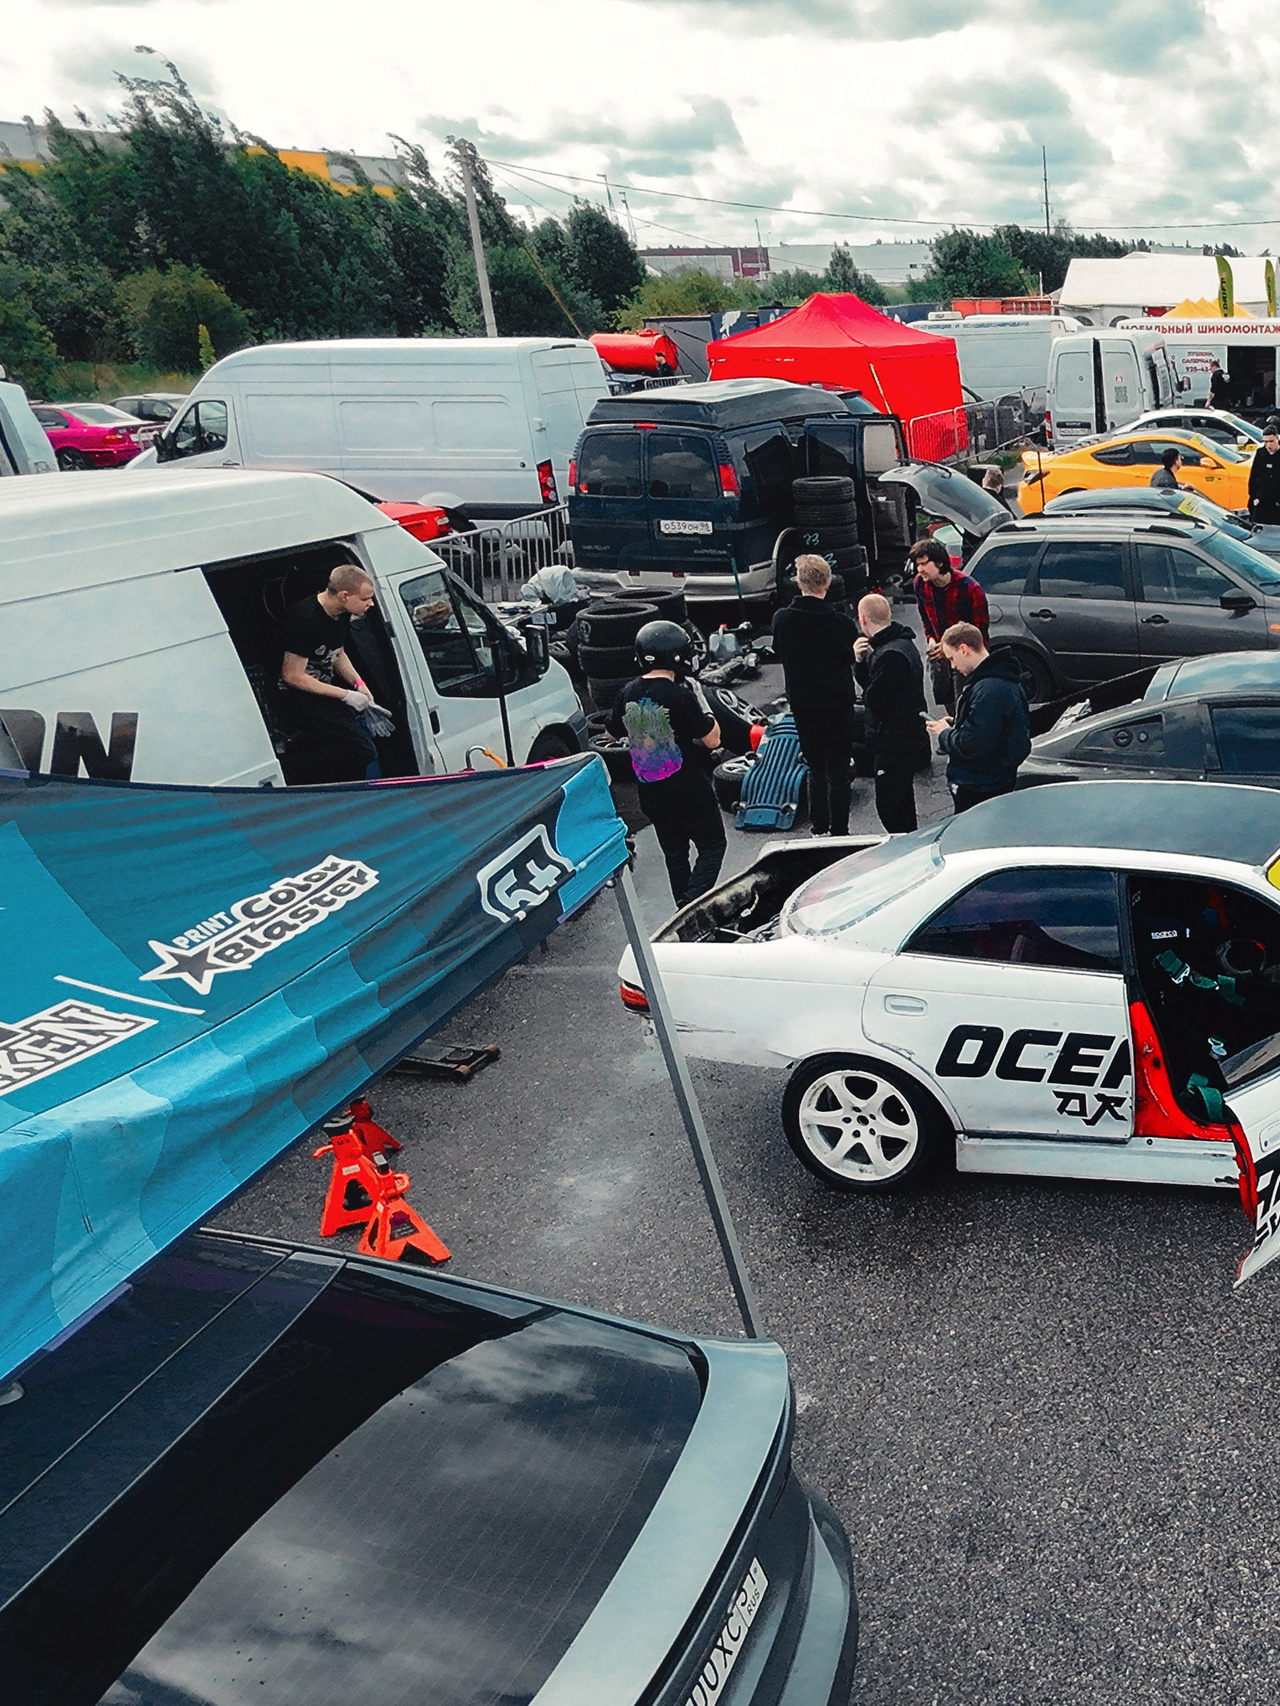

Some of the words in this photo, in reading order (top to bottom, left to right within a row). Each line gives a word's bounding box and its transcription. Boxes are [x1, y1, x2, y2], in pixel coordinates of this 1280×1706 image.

[213, 867, 370, 965] Blaster
[240, 860, 342, 920] Color
[172, 911, 235, 949] PRINT
[0, 1003, 145, 1090] KEN
[746, 1587, 761, 1617] RUS
